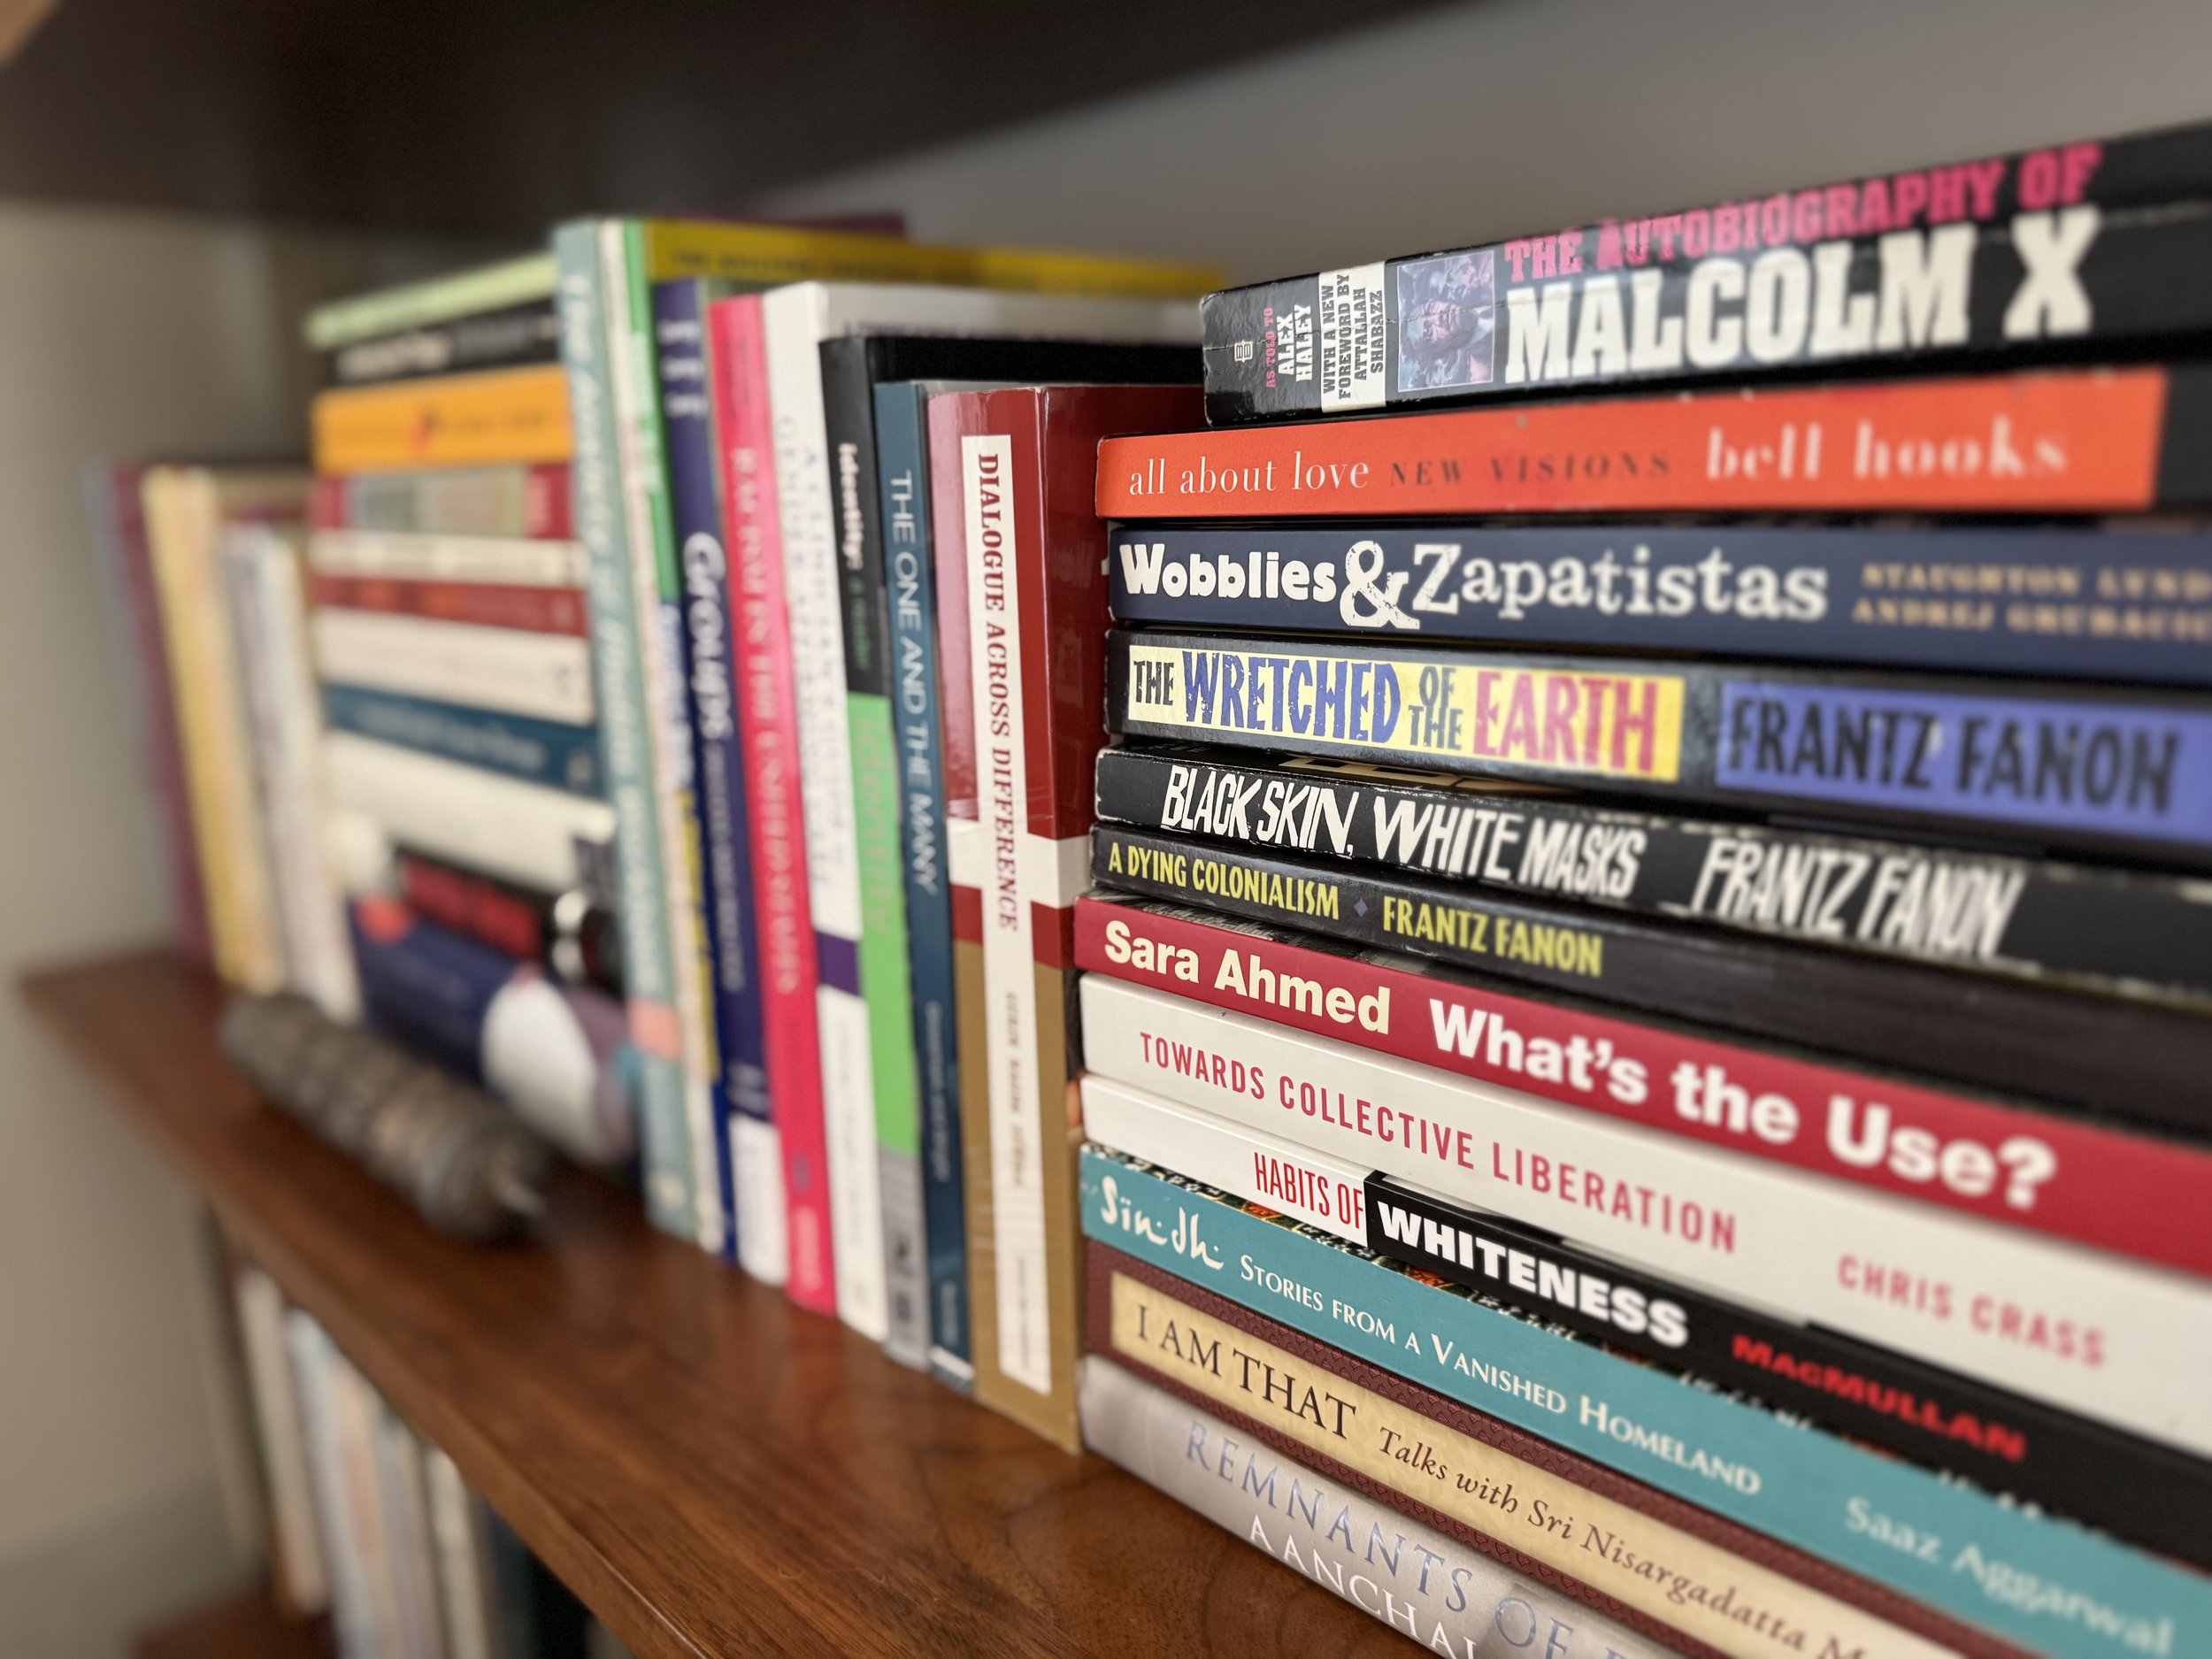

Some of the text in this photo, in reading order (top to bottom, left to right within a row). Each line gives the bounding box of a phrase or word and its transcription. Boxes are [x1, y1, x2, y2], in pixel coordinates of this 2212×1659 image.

[1505, 142, 2101, 281] THE AUTOBIOGRAPHY OF
[1263, 307, 1275, 388] AS TOLD TO
[1277, 313, 1294, 375] ALEX
[1294, 304, 1313, 381] HALEY
[1321, 285, 1335, 394] WITH A NEW
[1337, 274, 1351, 399] FOREWORD BY
[1353, 288, 1367, 380] ATTALLAH
[1370, 290, 1384, 373] SHABAZZ
[1505, 205, 2099, 383] MALCOLM X
[1129, 451, 1370, 496] all about love
[1389, 451, 1671, 487] NEW VISIONS
[1705, 413, 2069, 480] bell hooks
[1119, 540, 1828, 629] Wobblies & Zapatistas
[891, 471, 940, 896] THE ONE AND THE MANY
[979, 453, 1018, 933] DIALOGUE ACROSS DIFFERENCE
[1133, 650, 1457, 743] THE WRETCHED OF
[1409, 671, 1659, 772] THE EARTH
[1727, 697, 2179, 813] FRANTZ FANON
[1109, 841, 1340, 921] A DYING COLONIALISM
[1161, 765, 1647, 897] BLACK SKIN, WHITE MASKS
[1383, 895, 1603, 974] FRANTZ FANON
[1690, 836, 2026, 961] FRANTZ FANON
[1104, 920, 1391, 1035] Sara Ahmed
[1140, 1032, 1265, 1100] TOWARDS
[1279, 1074, 1475, 1170] COLLECTIVE
[1492, 1141, 1736, 1254] LIBERATION
[1429, 998, 2057, 1211] What's the Use?
[1254, 1152, 1363, 1230] HABITS OF
[1377, 1200, 1688, 1347] WHITENESS
[1837, 1254, 2107, 1367] CHRIS CRASS
[1138, 1305, 1357, 1442] I AM THAT
[1187, 1421, 1574, 1659] REMNANTS OF
[1379, 1425, 1448, 1481] Talks
[1455, 1469, 1518, 1514] with
[1527, 1500, 1573, 1540] Sri
[1580, 1521, 1805, 1651] Nisargadatta
[1845, 1496, 2173, 1659] Saaz Aggarwal
